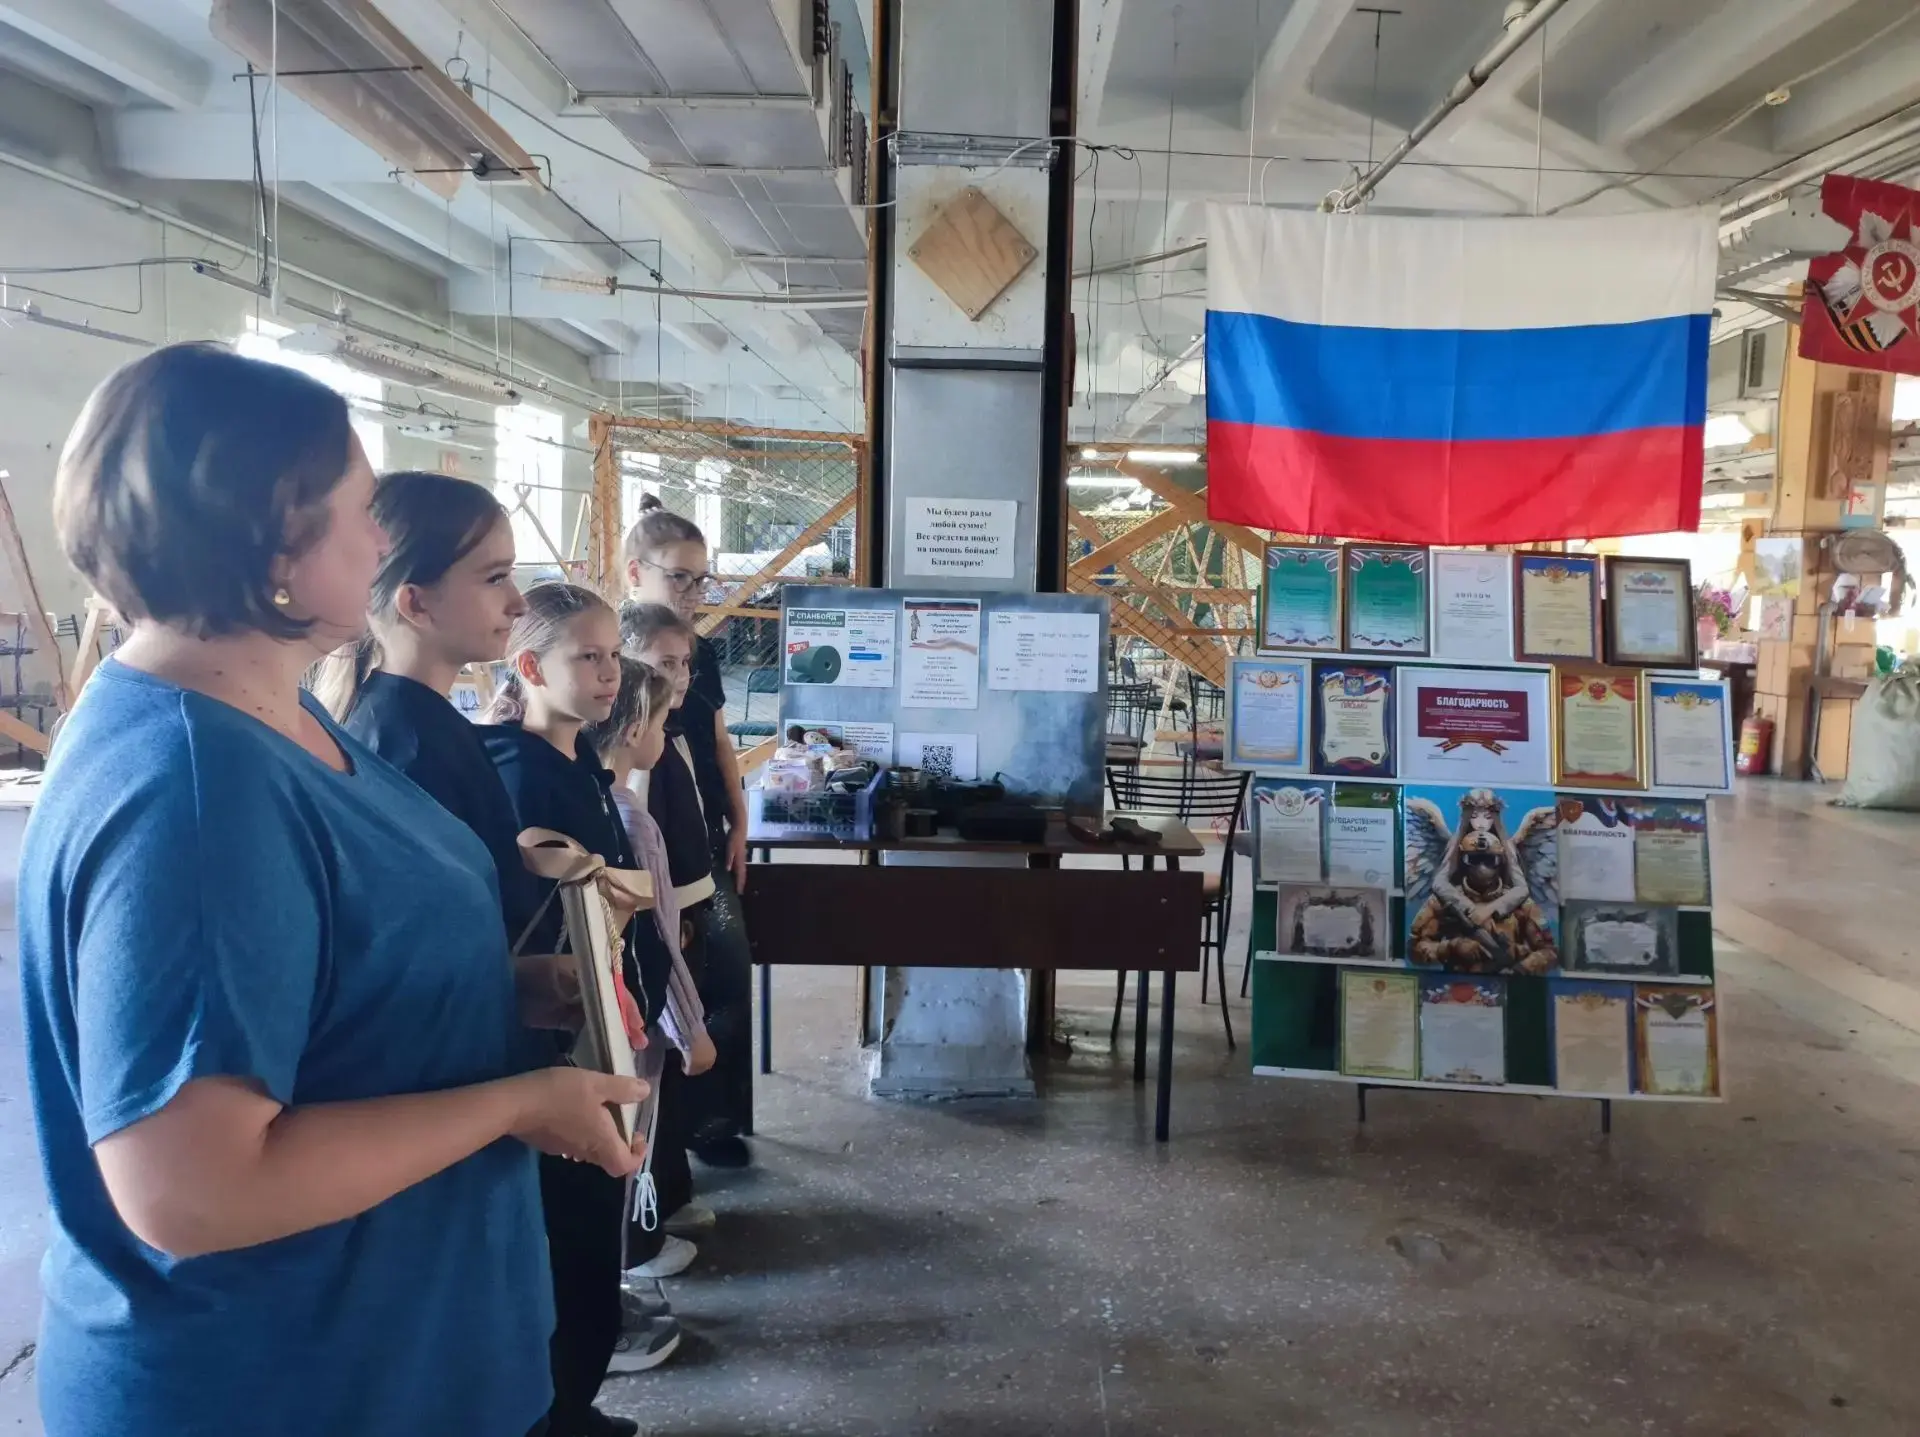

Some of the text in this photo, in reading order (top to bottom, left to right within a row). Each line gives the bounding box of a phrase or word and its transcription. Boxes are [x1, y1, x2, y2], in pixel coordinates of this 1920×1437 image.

[927, 507, 992, 518] Мы будем рады
[958, 521, 987, 530] сумме!
[916, 532, 999, 543] Все средства пойдут
[964, 546, 998, 555] бойцам!
[931, 558, 984, 568] Благодарим!
[796, 612, 837, 621] СПАНБОНД
[1436, 696, 1509, 709] БЛАГОДАРНОСТЬ
